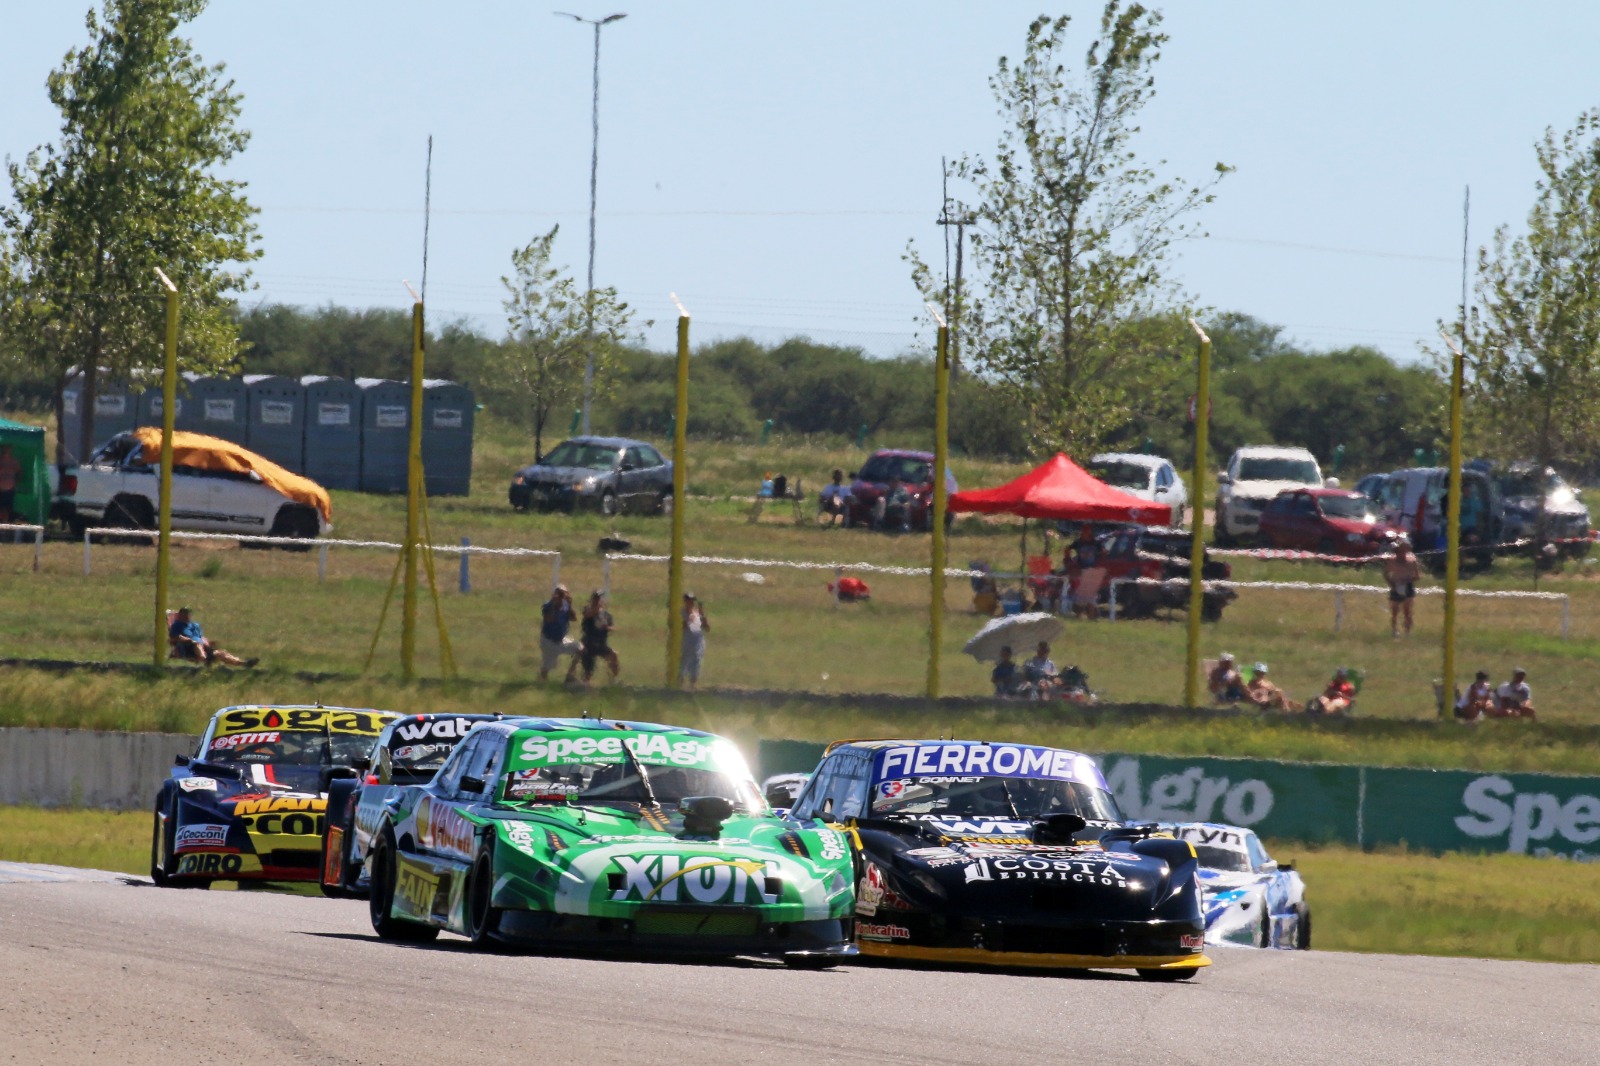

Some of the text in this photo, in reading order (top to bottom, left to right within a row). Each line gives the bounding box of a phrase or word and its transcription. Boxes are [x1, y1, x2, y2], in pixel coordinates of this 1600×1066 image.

[519, 733, 718, 765] SpeedAgr
[918, 776, 984, 784] GONNET
[183, 830, 225, 840] Cecconi
[993, 859, 1126, 880] COSTA
[611, 855, 780, 904] XION
[1000, 871, 1127, 888] EDIFICIOS
